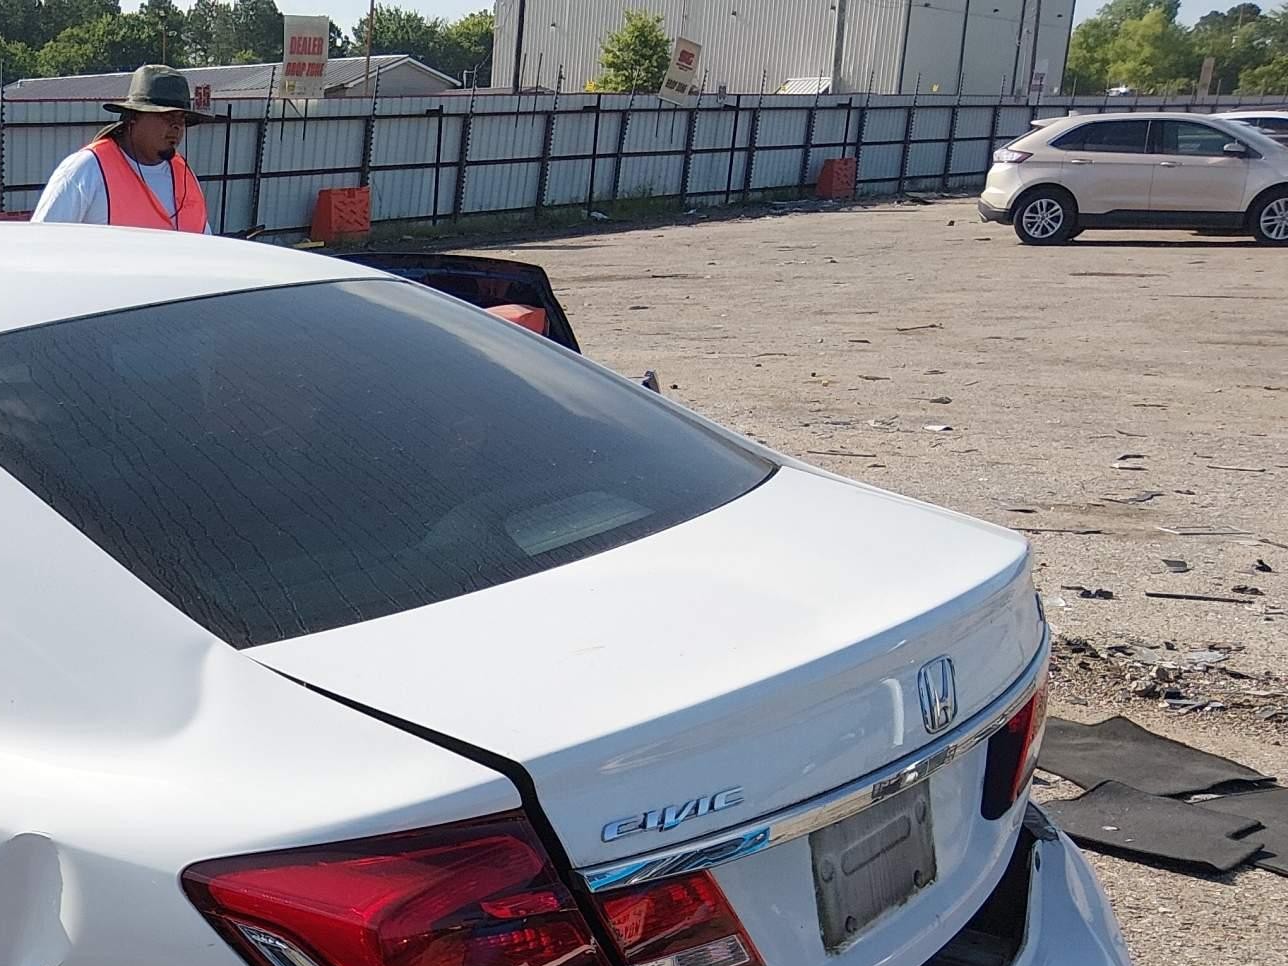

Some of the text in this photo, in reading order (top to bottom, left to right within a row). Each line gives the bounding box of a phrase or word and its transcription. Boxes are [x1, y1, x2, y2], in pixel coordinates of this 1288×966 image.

[289, 36, 324, 55] DEALER
[285, 62, 307, 77] DROP
[601, 785, 745, 843] CIVIC
